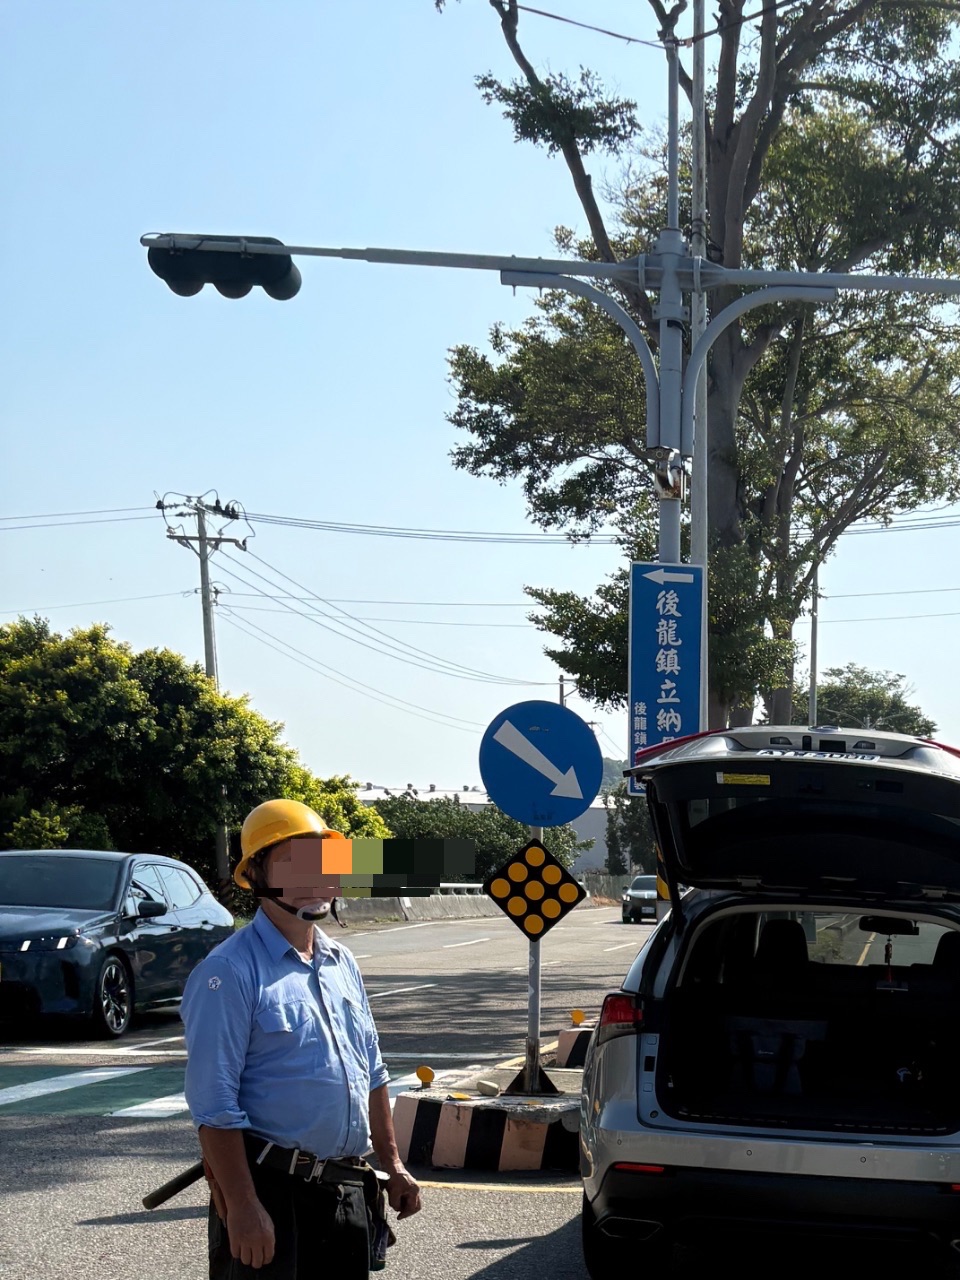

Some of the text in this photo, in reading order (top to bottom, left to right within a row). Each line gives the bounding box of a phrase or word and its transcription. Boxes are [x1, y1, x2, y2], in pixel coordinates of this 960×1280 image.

[655, 589, 682, 743] 後龍鎮立納
